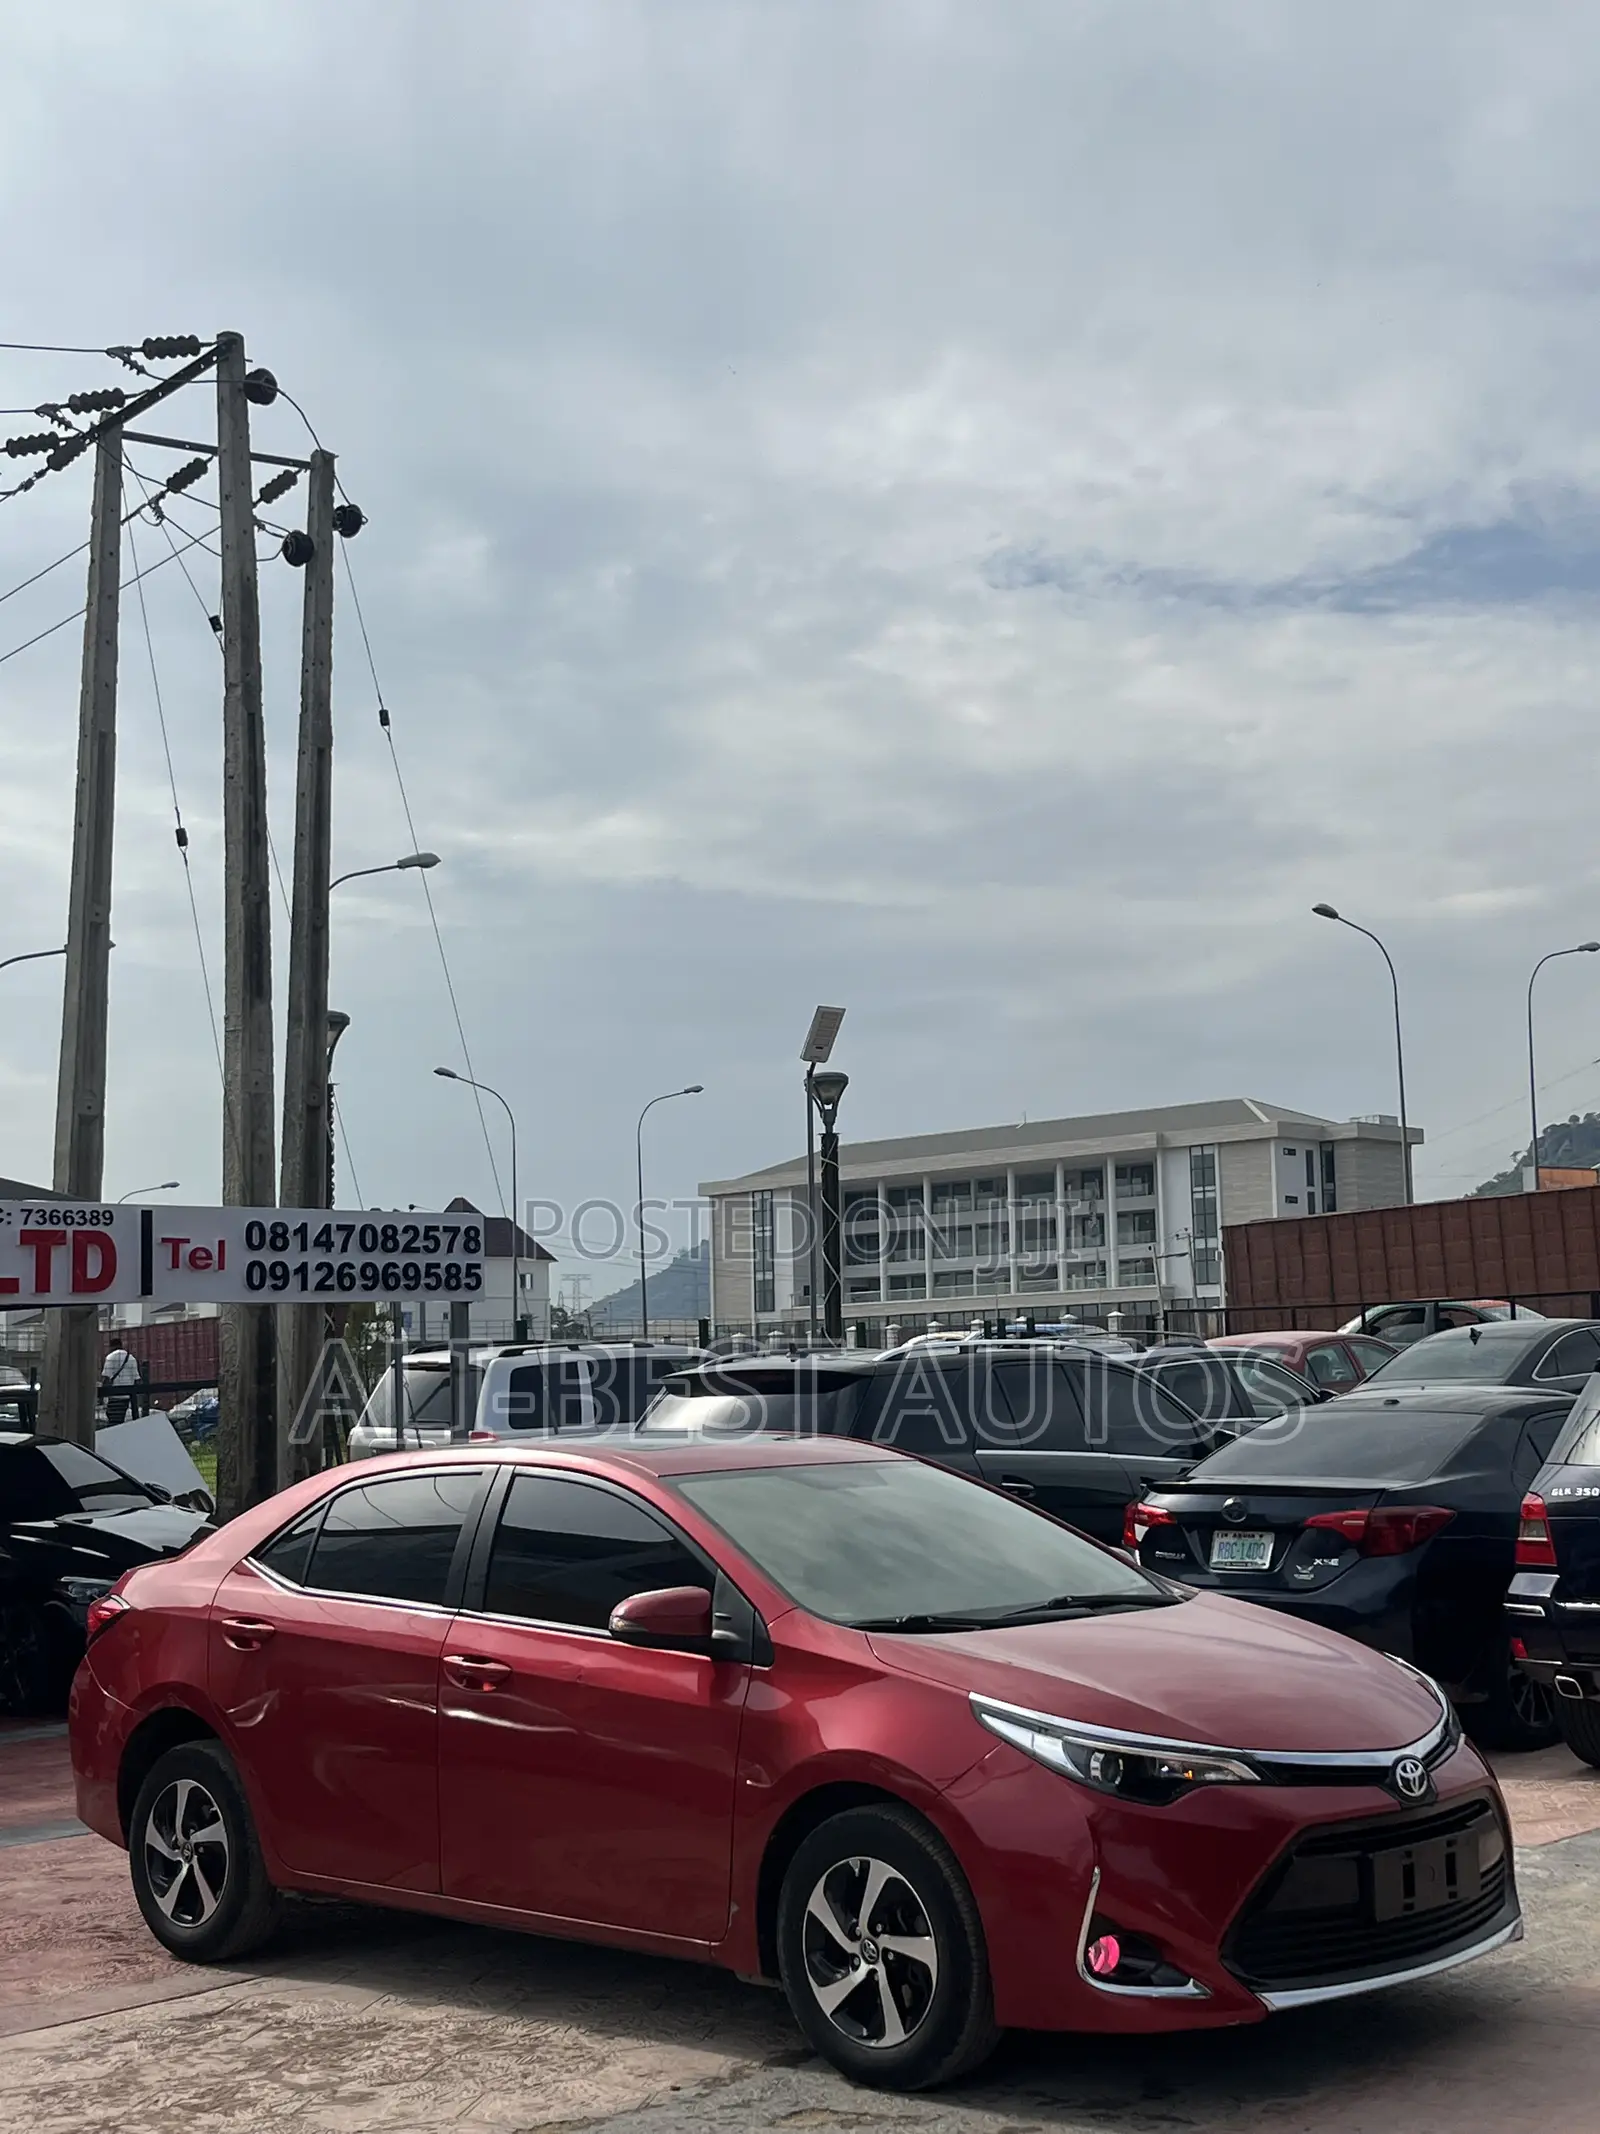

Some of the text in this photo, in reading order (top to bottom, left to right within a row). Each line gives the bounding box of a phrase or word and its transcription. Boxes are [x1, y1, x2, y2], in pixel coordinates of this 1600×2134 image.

[20, 1208, 114, 1226] 7366389
[245, 1220, 482, 1254] 08147082578
[161, 1237, 225, 1271] Tel
[246, 1260, 483, 1292] 09126969585
[1574, 1487, 1600, 1496] 350
